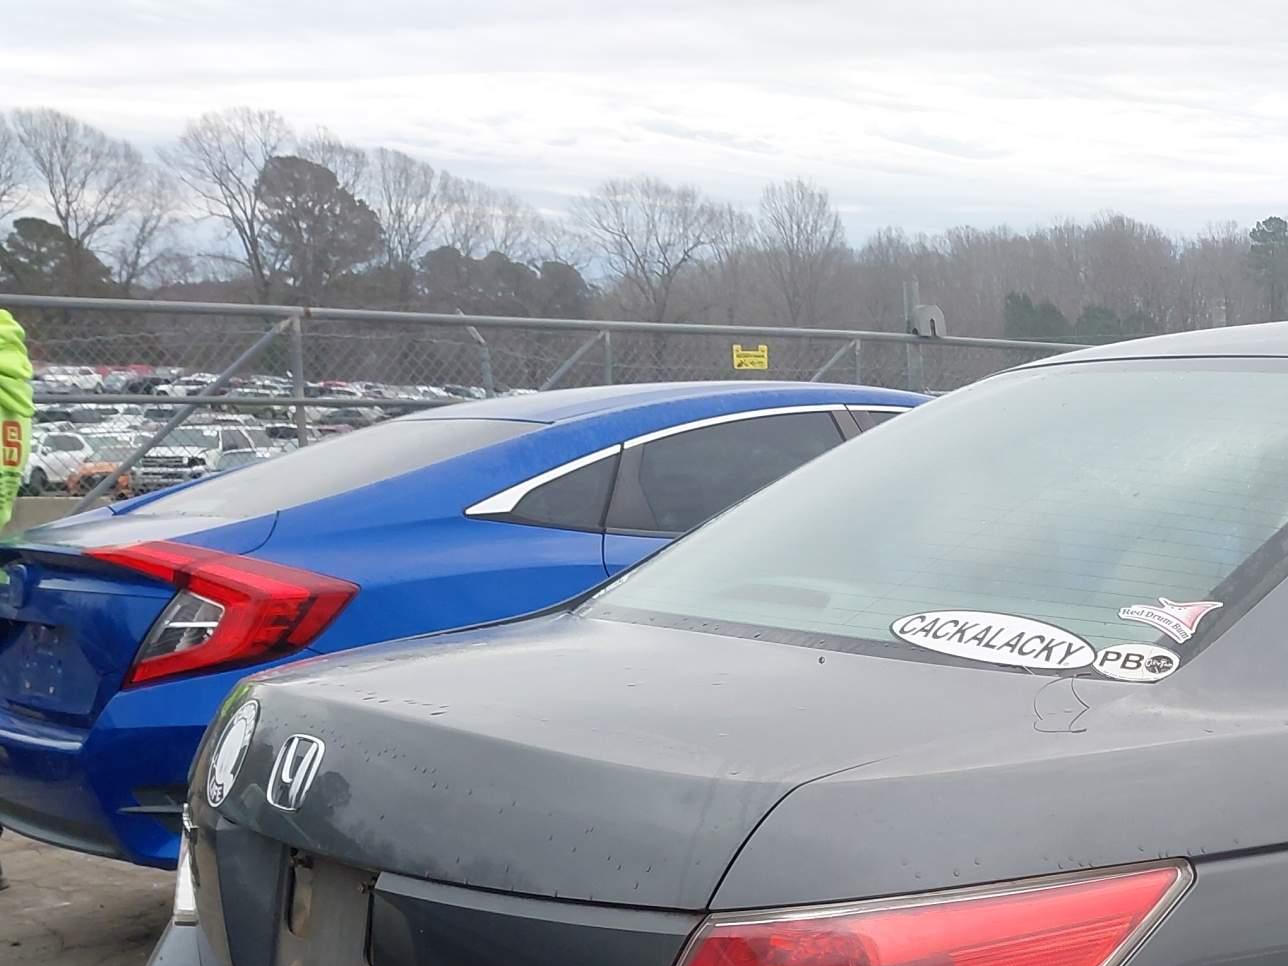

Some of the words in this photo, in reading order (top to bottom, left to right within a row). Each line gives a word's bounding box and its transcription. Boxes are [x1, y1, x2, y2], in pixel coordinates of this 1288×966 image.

[1121, 608, 1145, 617] Red
[1145, 610, 1172, 626] Drum
[899, 615, 1085, 665] CACKALACKY
